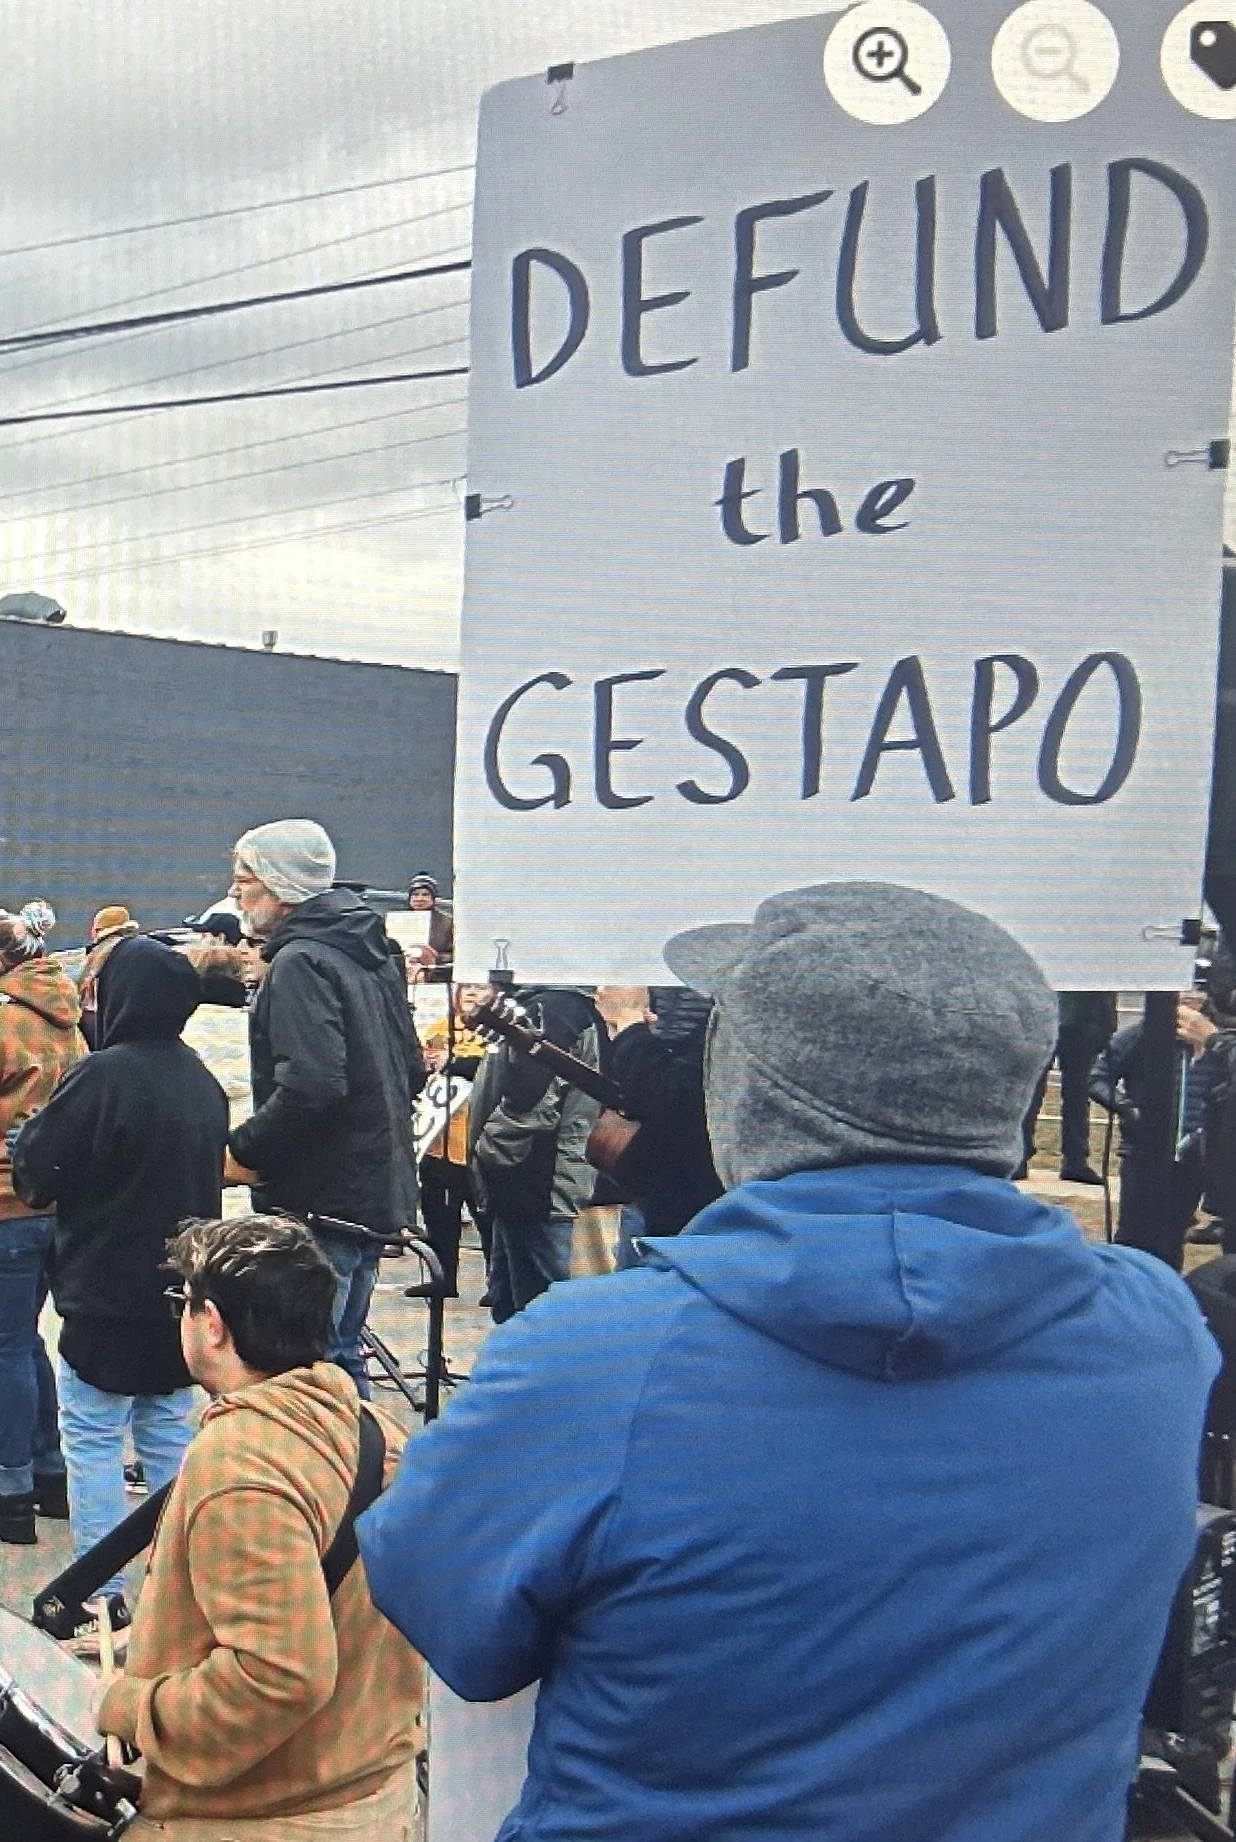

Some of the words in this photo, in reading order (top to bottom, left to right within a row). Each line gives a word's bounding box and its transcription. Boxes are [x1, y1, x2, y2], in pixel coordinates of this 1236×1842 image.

[510, 157, 1211, 390] DEFUND
[714, 447, 917, 547] the
[483, 650, 1144, 812] GESTAPO
